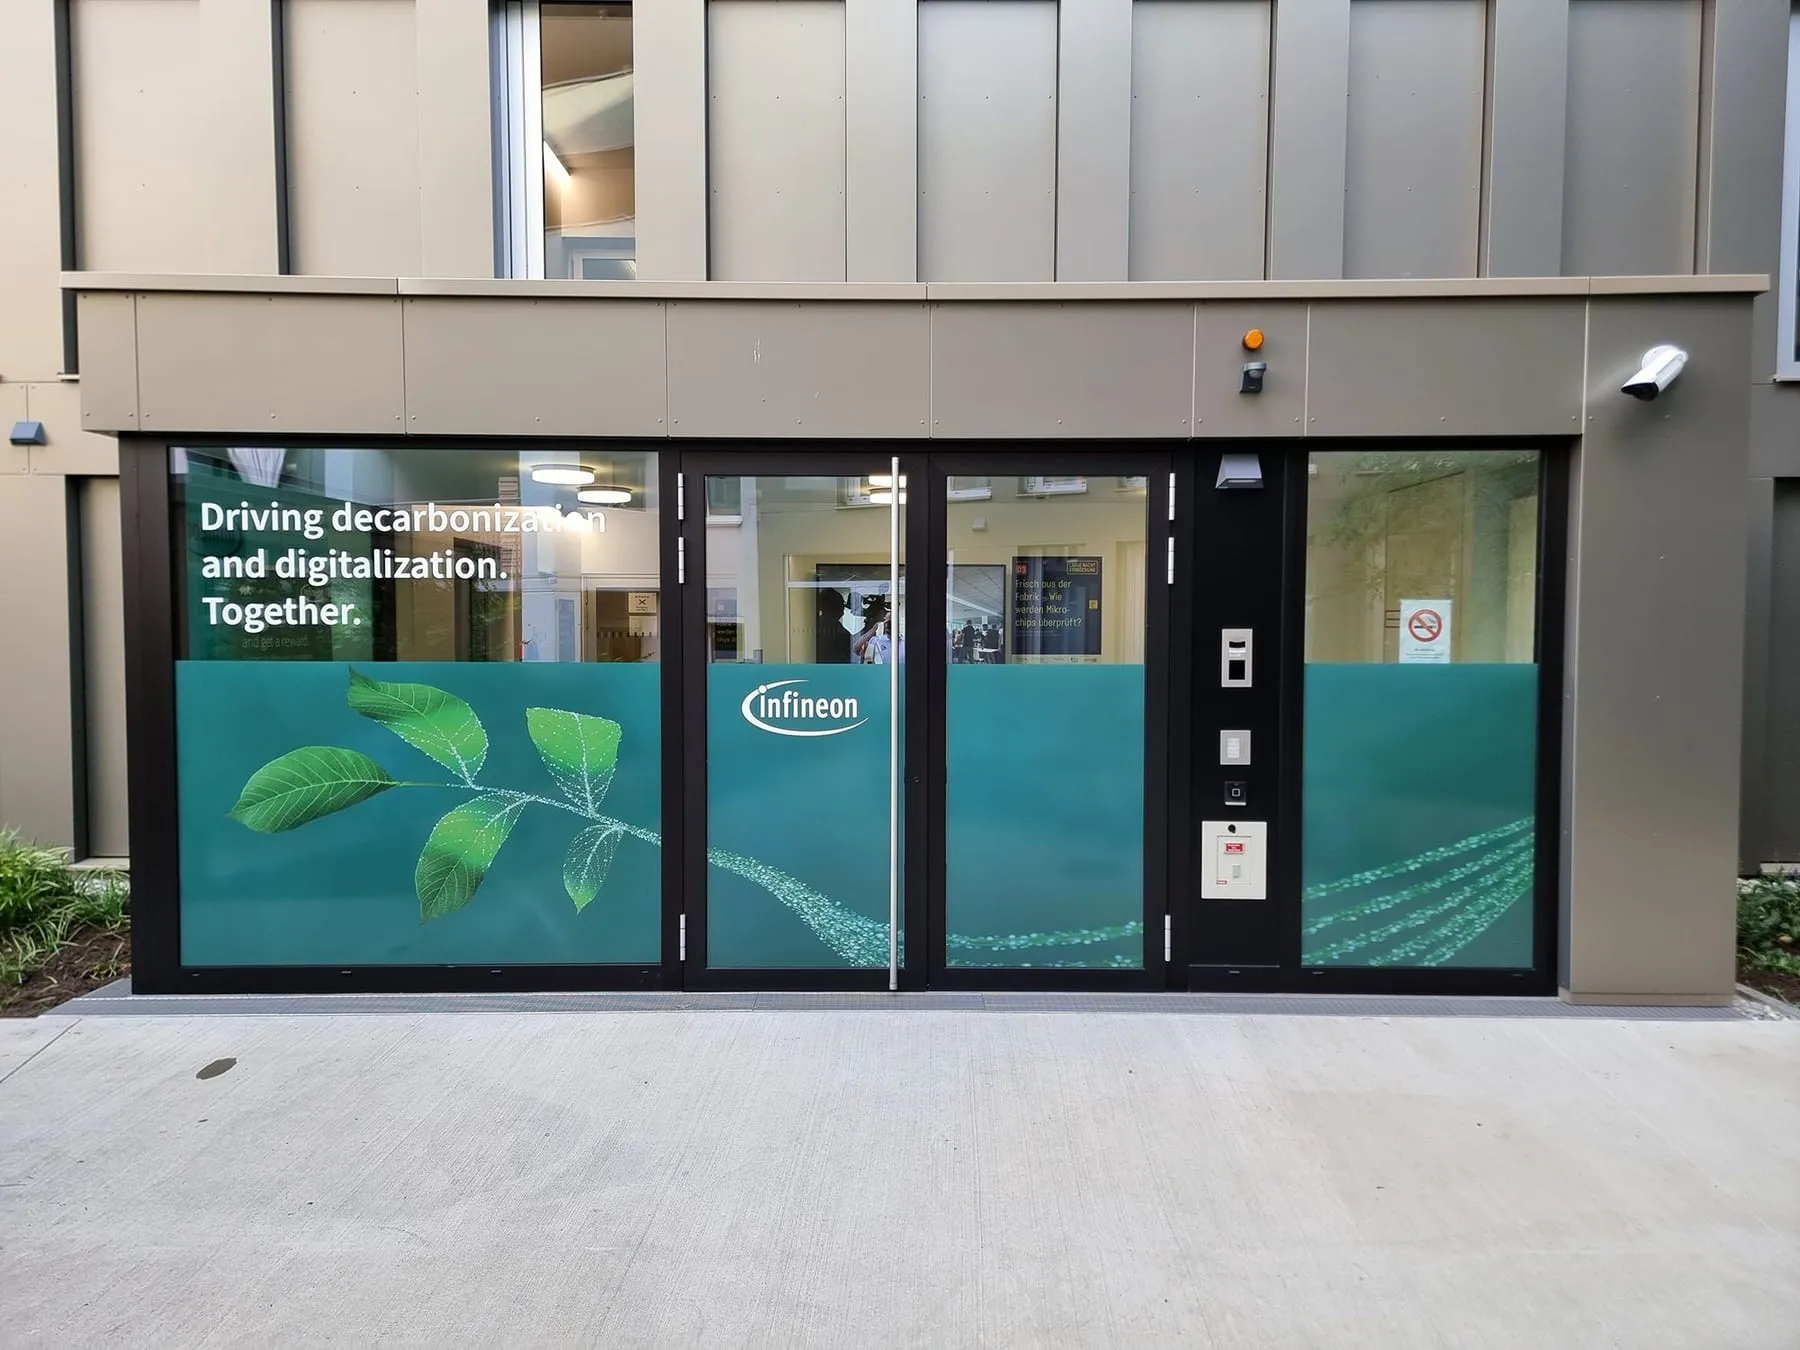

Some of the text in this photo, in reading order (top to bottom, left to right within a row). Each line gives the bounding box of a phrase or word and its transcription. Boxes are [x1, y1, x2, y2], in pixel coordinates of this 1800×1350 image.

[201, 501, 324, 540] Driving
[202, 548, 508, 587] and digitalization.
[1015, 580, 1072, 589] Frisch aus der
[1015, 592, 1041, 601] Fabrik
[1049, 592, 1062, 601] Wie
[202, 596, 361, 634] Together.
[1015, 605, 1070, 614] werden Mikro-
[1015, 618, 1082, 629] chips überprüft?
